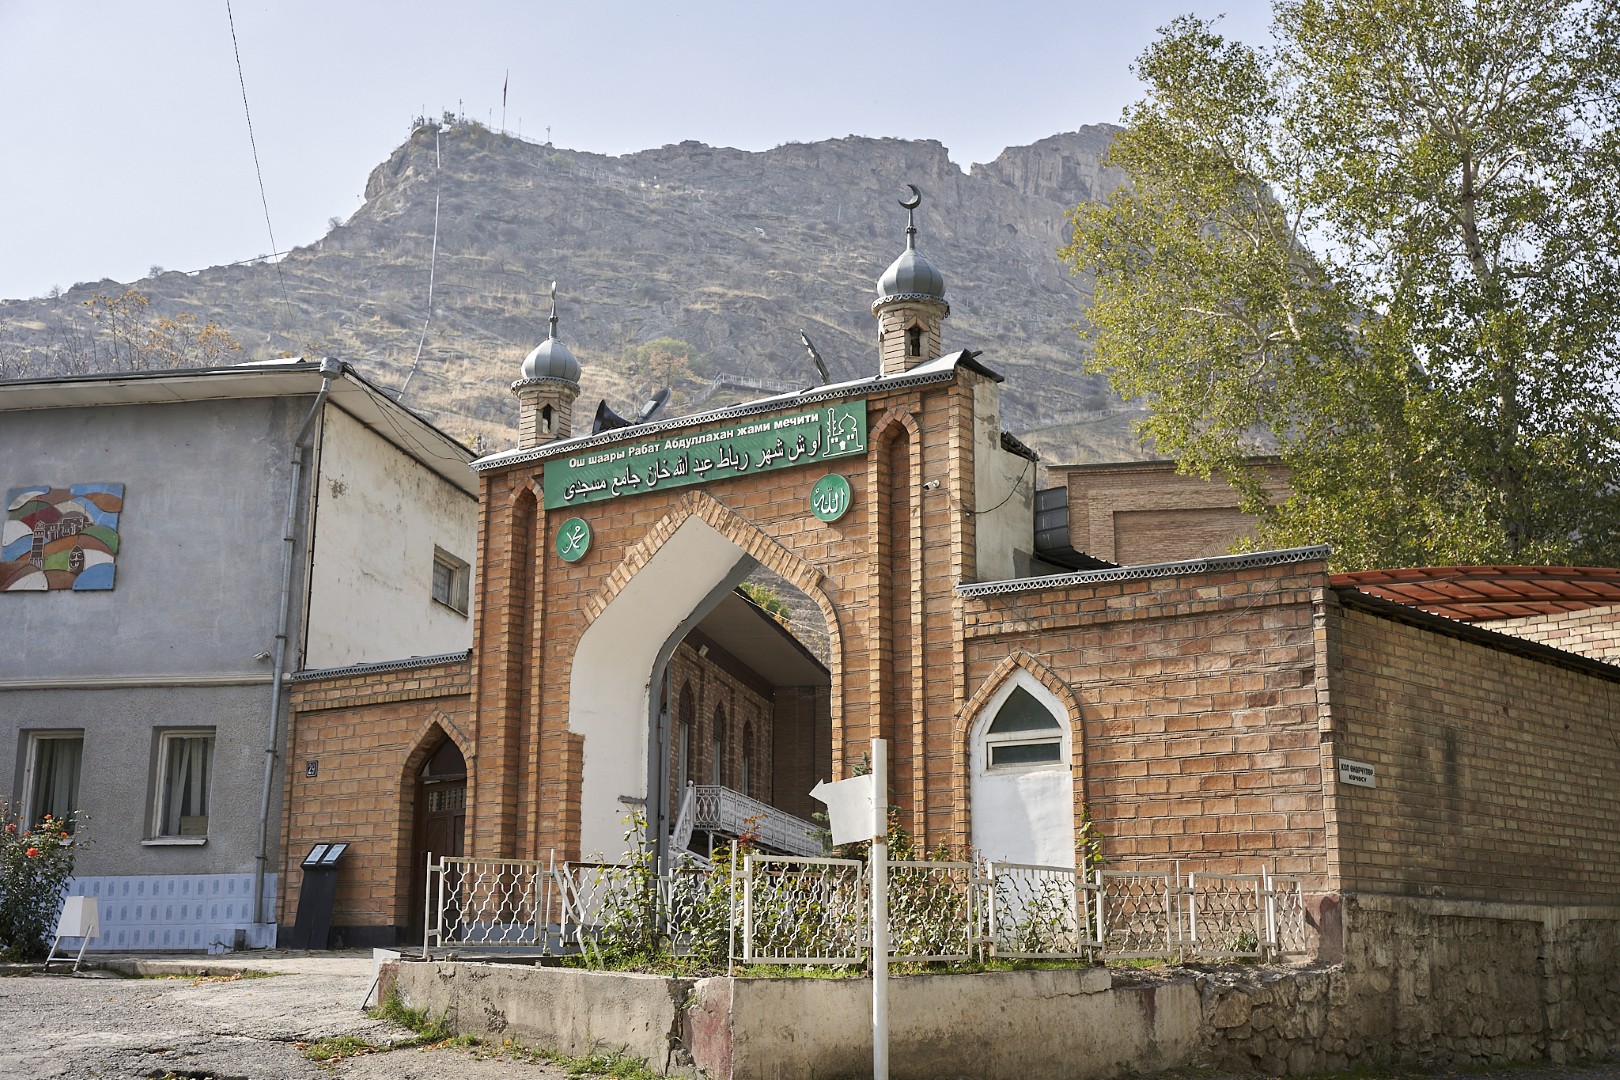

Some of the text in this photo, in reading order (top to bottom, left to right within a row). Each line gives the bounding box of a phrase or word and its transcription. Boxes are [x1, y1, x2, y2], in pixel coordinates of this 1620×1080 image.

[568, 412, 819, 468] Ош шаары Рабат Абдуллахан жами мечити
[755, 438, 784, 469] شهر
[692, 456, 713, 477] عبد
[716, 446, 749, 471] رباط
[611, 464, 641, 497] جامع
